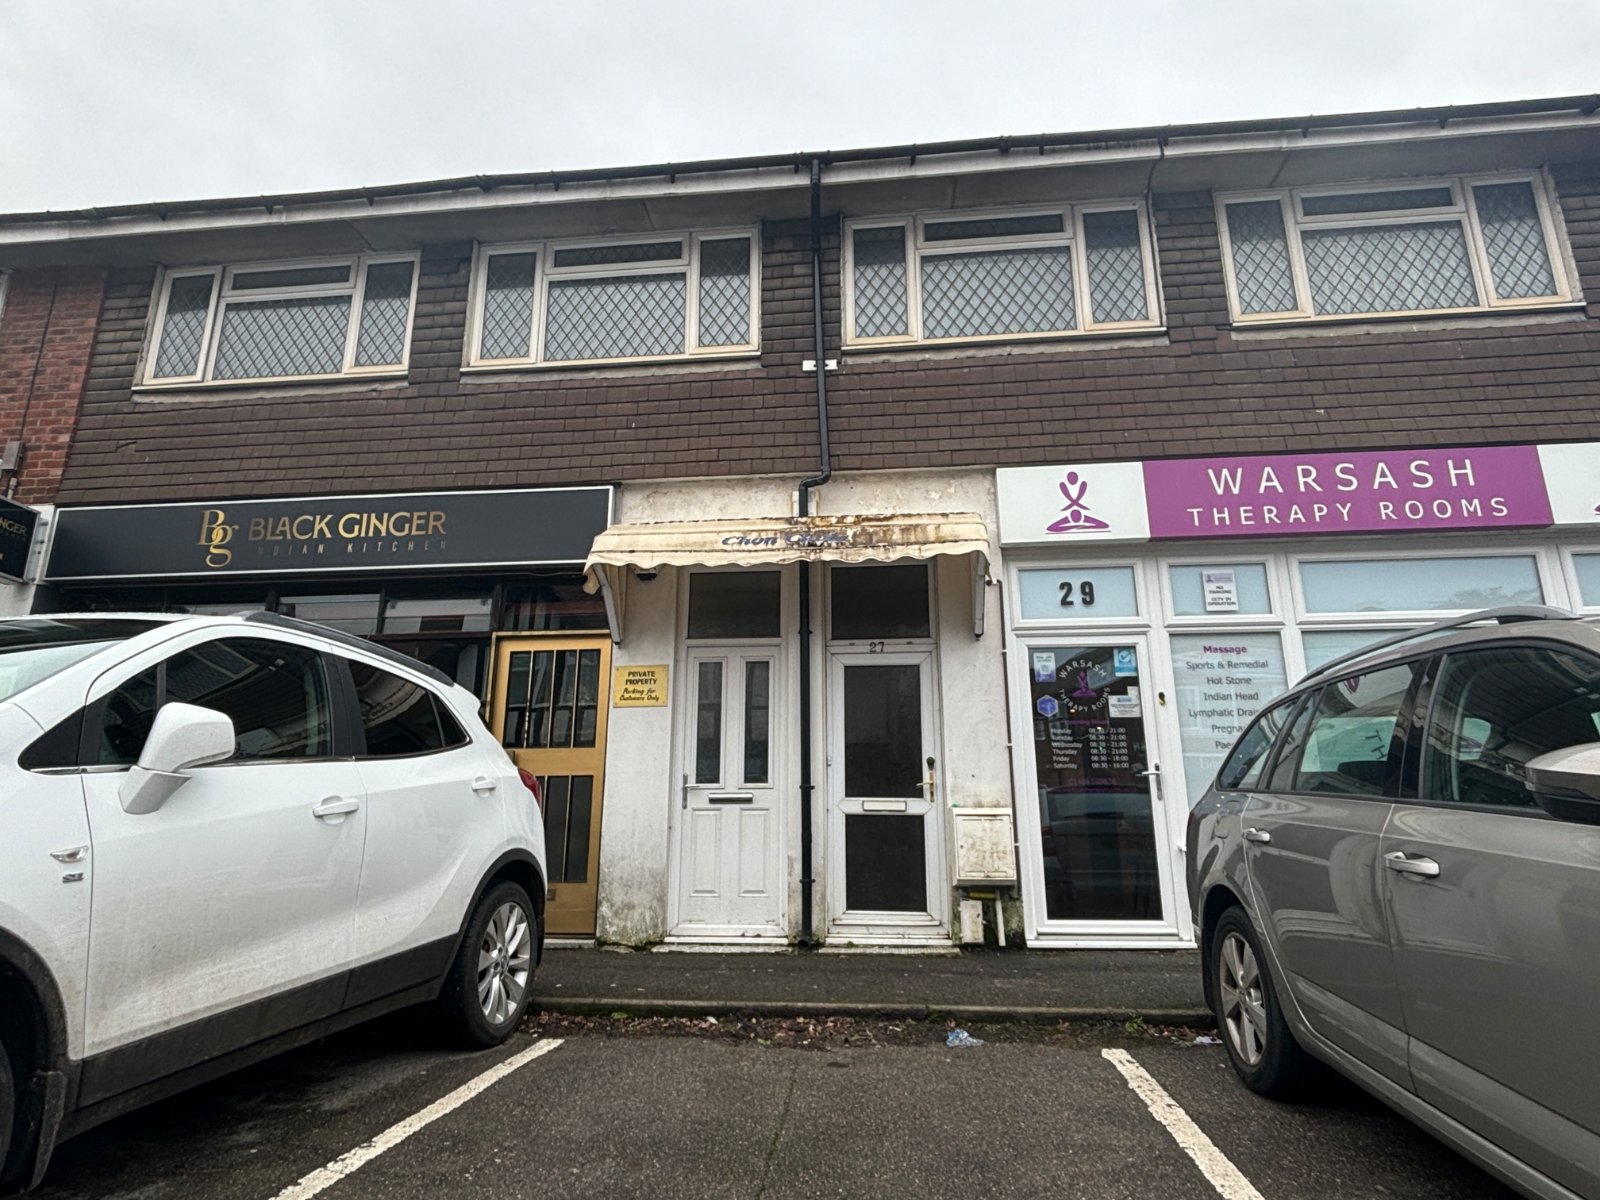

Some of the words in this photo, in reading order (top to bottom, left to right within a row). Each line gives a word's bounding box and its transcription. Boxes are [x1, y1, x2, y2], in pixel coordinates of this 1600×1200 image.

[1207, 458, 1475, 495] WARSASH
[1186, 502, 1352, 527] THERAPY
[1379, 497, 1508, 520] ROOMS
[247, 514, 334, 541] BLACK
[337, 511, 447, 538] GINGER
[254, 543, 325, 556] NDIAN
[347, 540, 447, 553] KITCHEN
[1059, 581, 1095, 606] 29
[869, 641, 885, 653] 27
[1203, 645, 1248, 655] Massage
[1059, 660, 1107, 678] WARSASH
[1186, 661, 1215, 671] Sports
[1217, 661, 1225, 669] &
[1227, 660, 1268, 669] Remedial
[1207, 677, 1223, 685] Hot
[1225, 676, 1252, 685] Stone
[623, 687, 645, 696] Parking
[1203, 692, 1233, 701] Indian
[1235, 692, 1259, 700] Head
[646, 694, 659, 702] Only
[1059, 688, 1088, 712] THERAPY
[1092, 687, 1111, 711] ROOMS
[1188, 708, 1234, 718] Lymphatic
[1215, 741, 1233, 749] Pae
